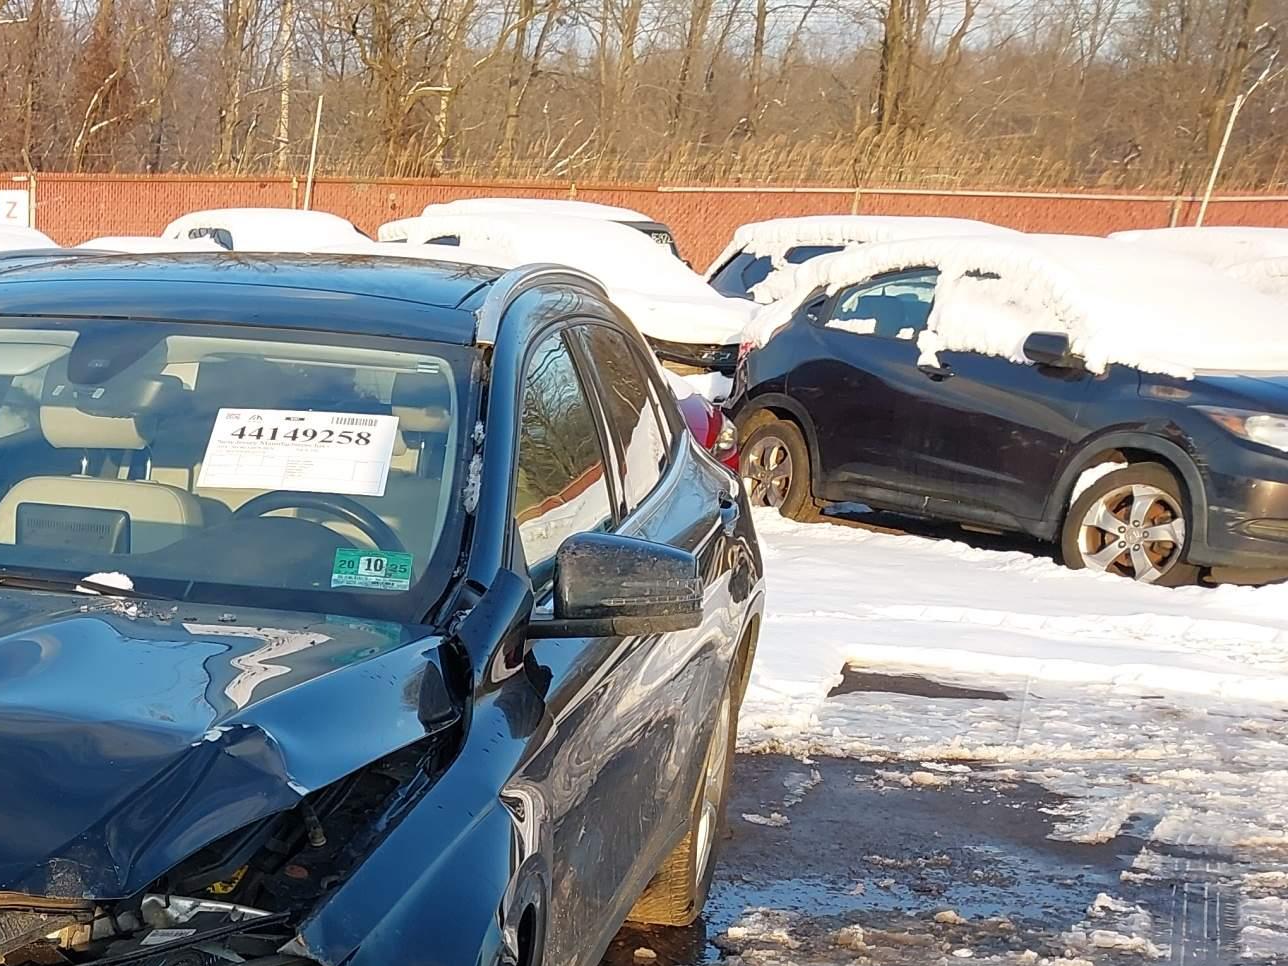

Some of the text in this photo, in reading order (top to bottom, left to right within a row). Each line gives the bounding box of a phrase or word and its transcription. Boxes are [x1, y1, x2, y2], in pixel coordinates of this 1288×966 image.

[5, 201, 17, 219] Z
[230, 426, 373, 446] 44149258
[364, 558, 384, 572] 10
